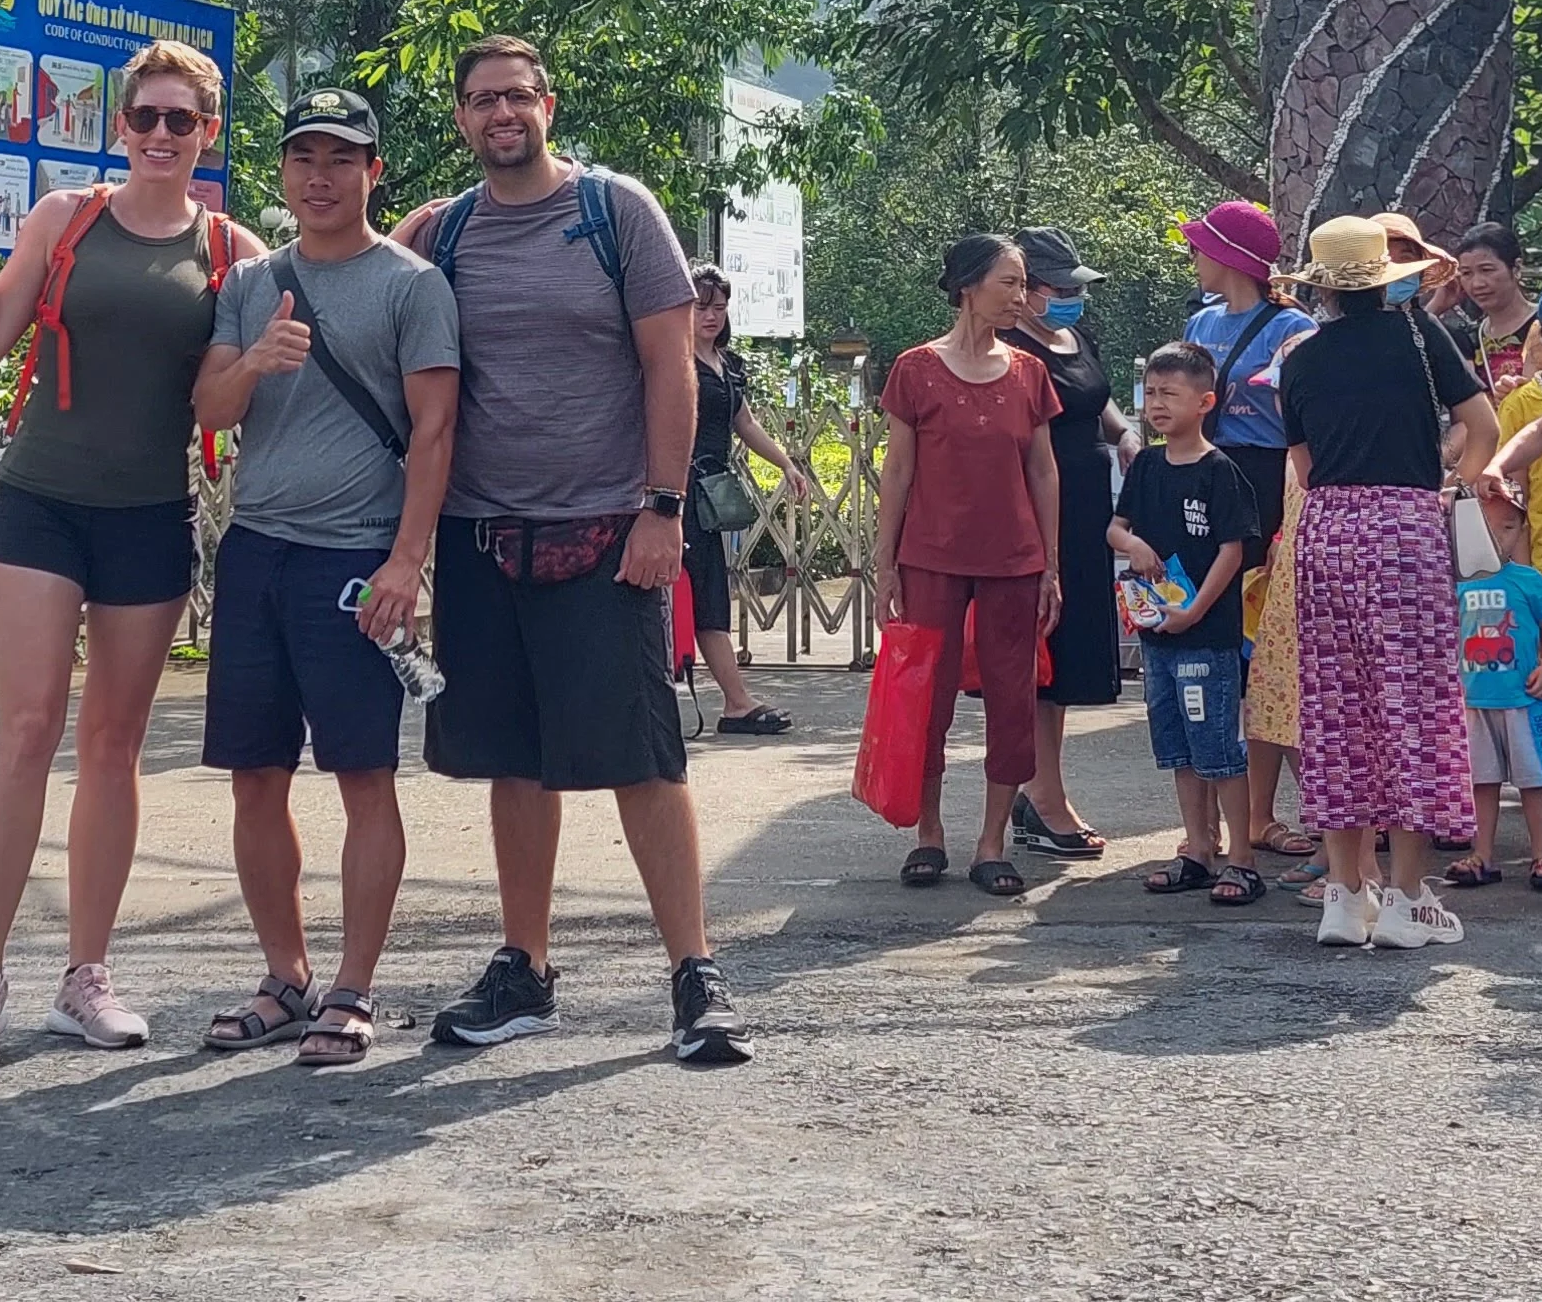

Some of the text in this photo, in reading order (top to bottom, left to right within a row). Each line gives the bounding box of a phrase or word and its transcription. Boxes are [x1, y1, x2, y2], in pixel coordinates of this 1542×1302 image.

[45, 22, 70, 40] CODE
[71, 27, 82, 42] OF
[83, 30, 124, 50] CONDUCT
[1410, 905, 1458, 932] BOSTON
